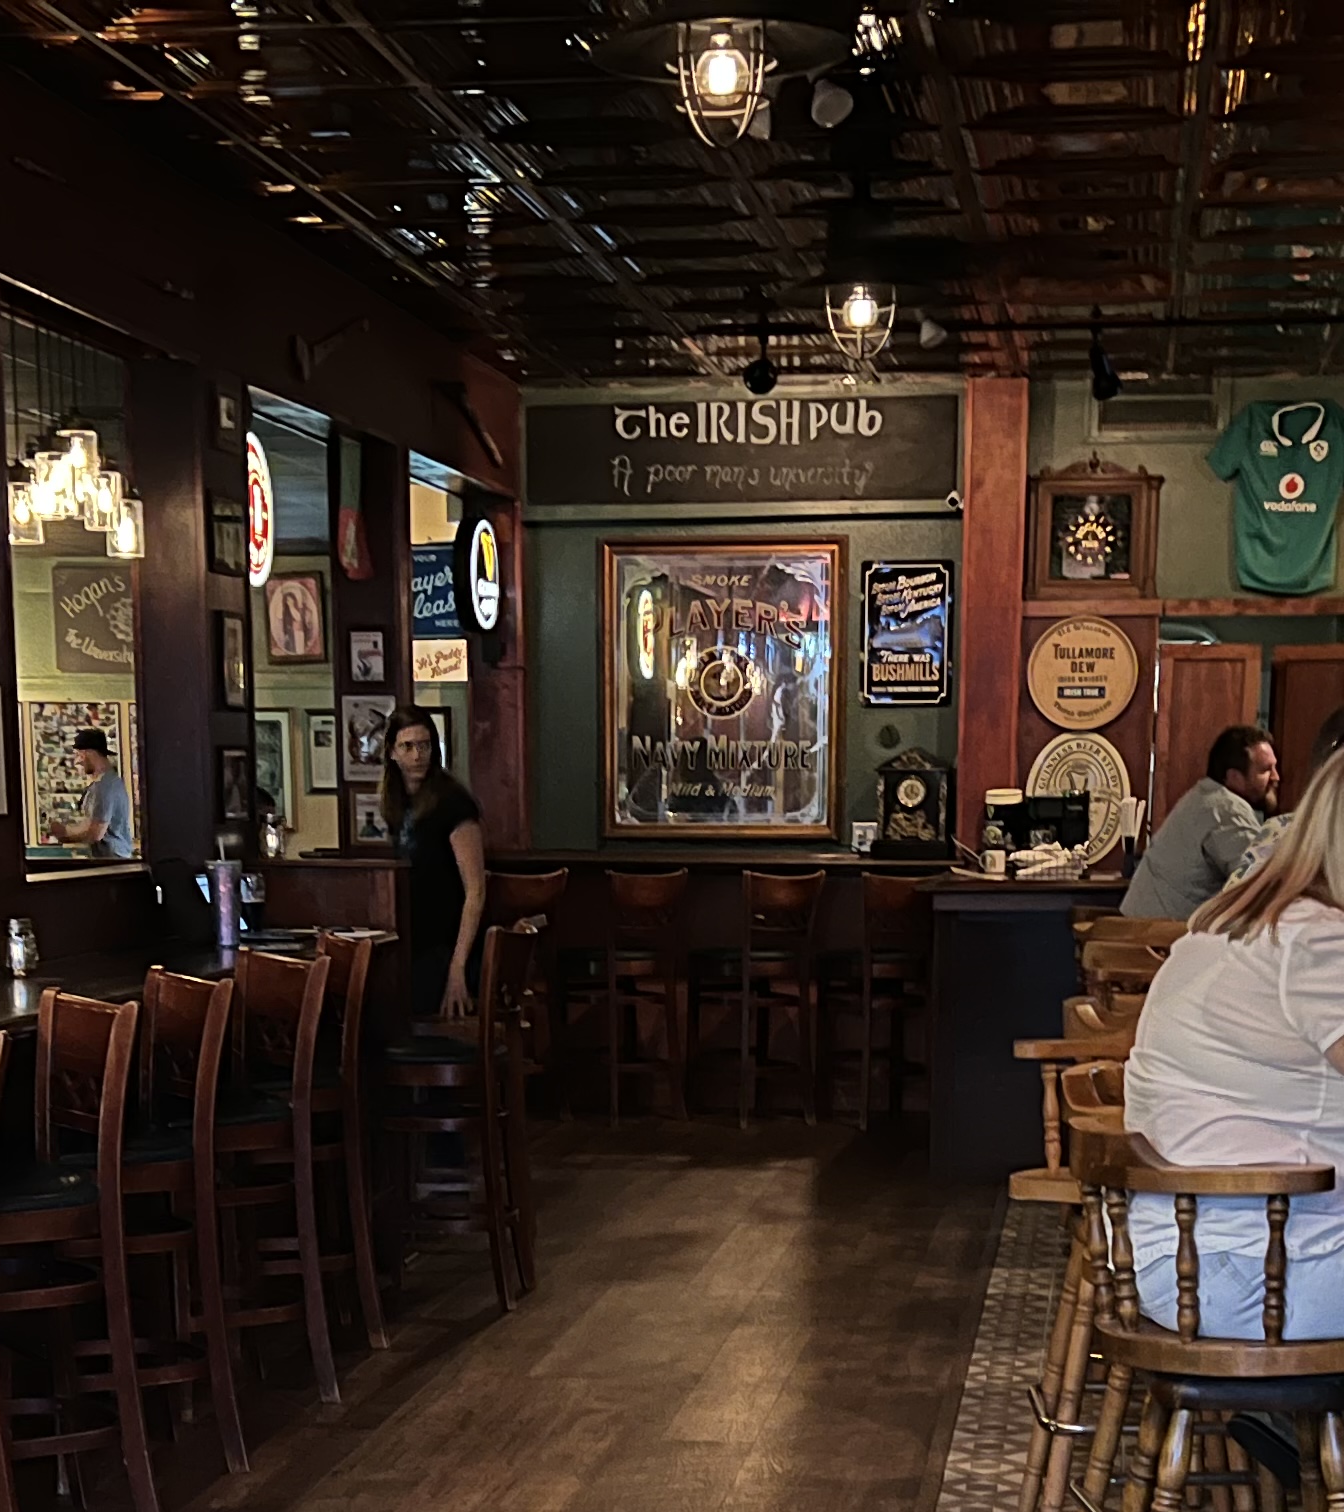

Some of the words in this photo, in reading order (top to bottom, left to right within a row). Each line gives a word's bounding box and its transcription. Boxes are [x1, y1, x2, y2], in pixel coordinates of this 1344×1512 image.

[613, 404, 691, 440] The
[696, 400, 801, 445] IRISH
[1263, 501, 1317, 513] vodafone
[690, 574, 753, 587] SMOKE
[59, 573, 126, 618] Hogan's
[1052, 643, 1116, 661] TULLAMORE
[872, 662, 940, 681] BUSHMILLS
[1070, 661, 1096, 674] DEW
[631, 735, 701, 771] NAVY
[706, 734, 813, 771] MIXTURE
[1038, 743, 1074, 790] GUINNESS
[1076, 742, 1102, 756] BEER
[668, 781, 702, 798] Mild
[705, 784, 716, 797] &
[719, 782, 777, 799] Medium
